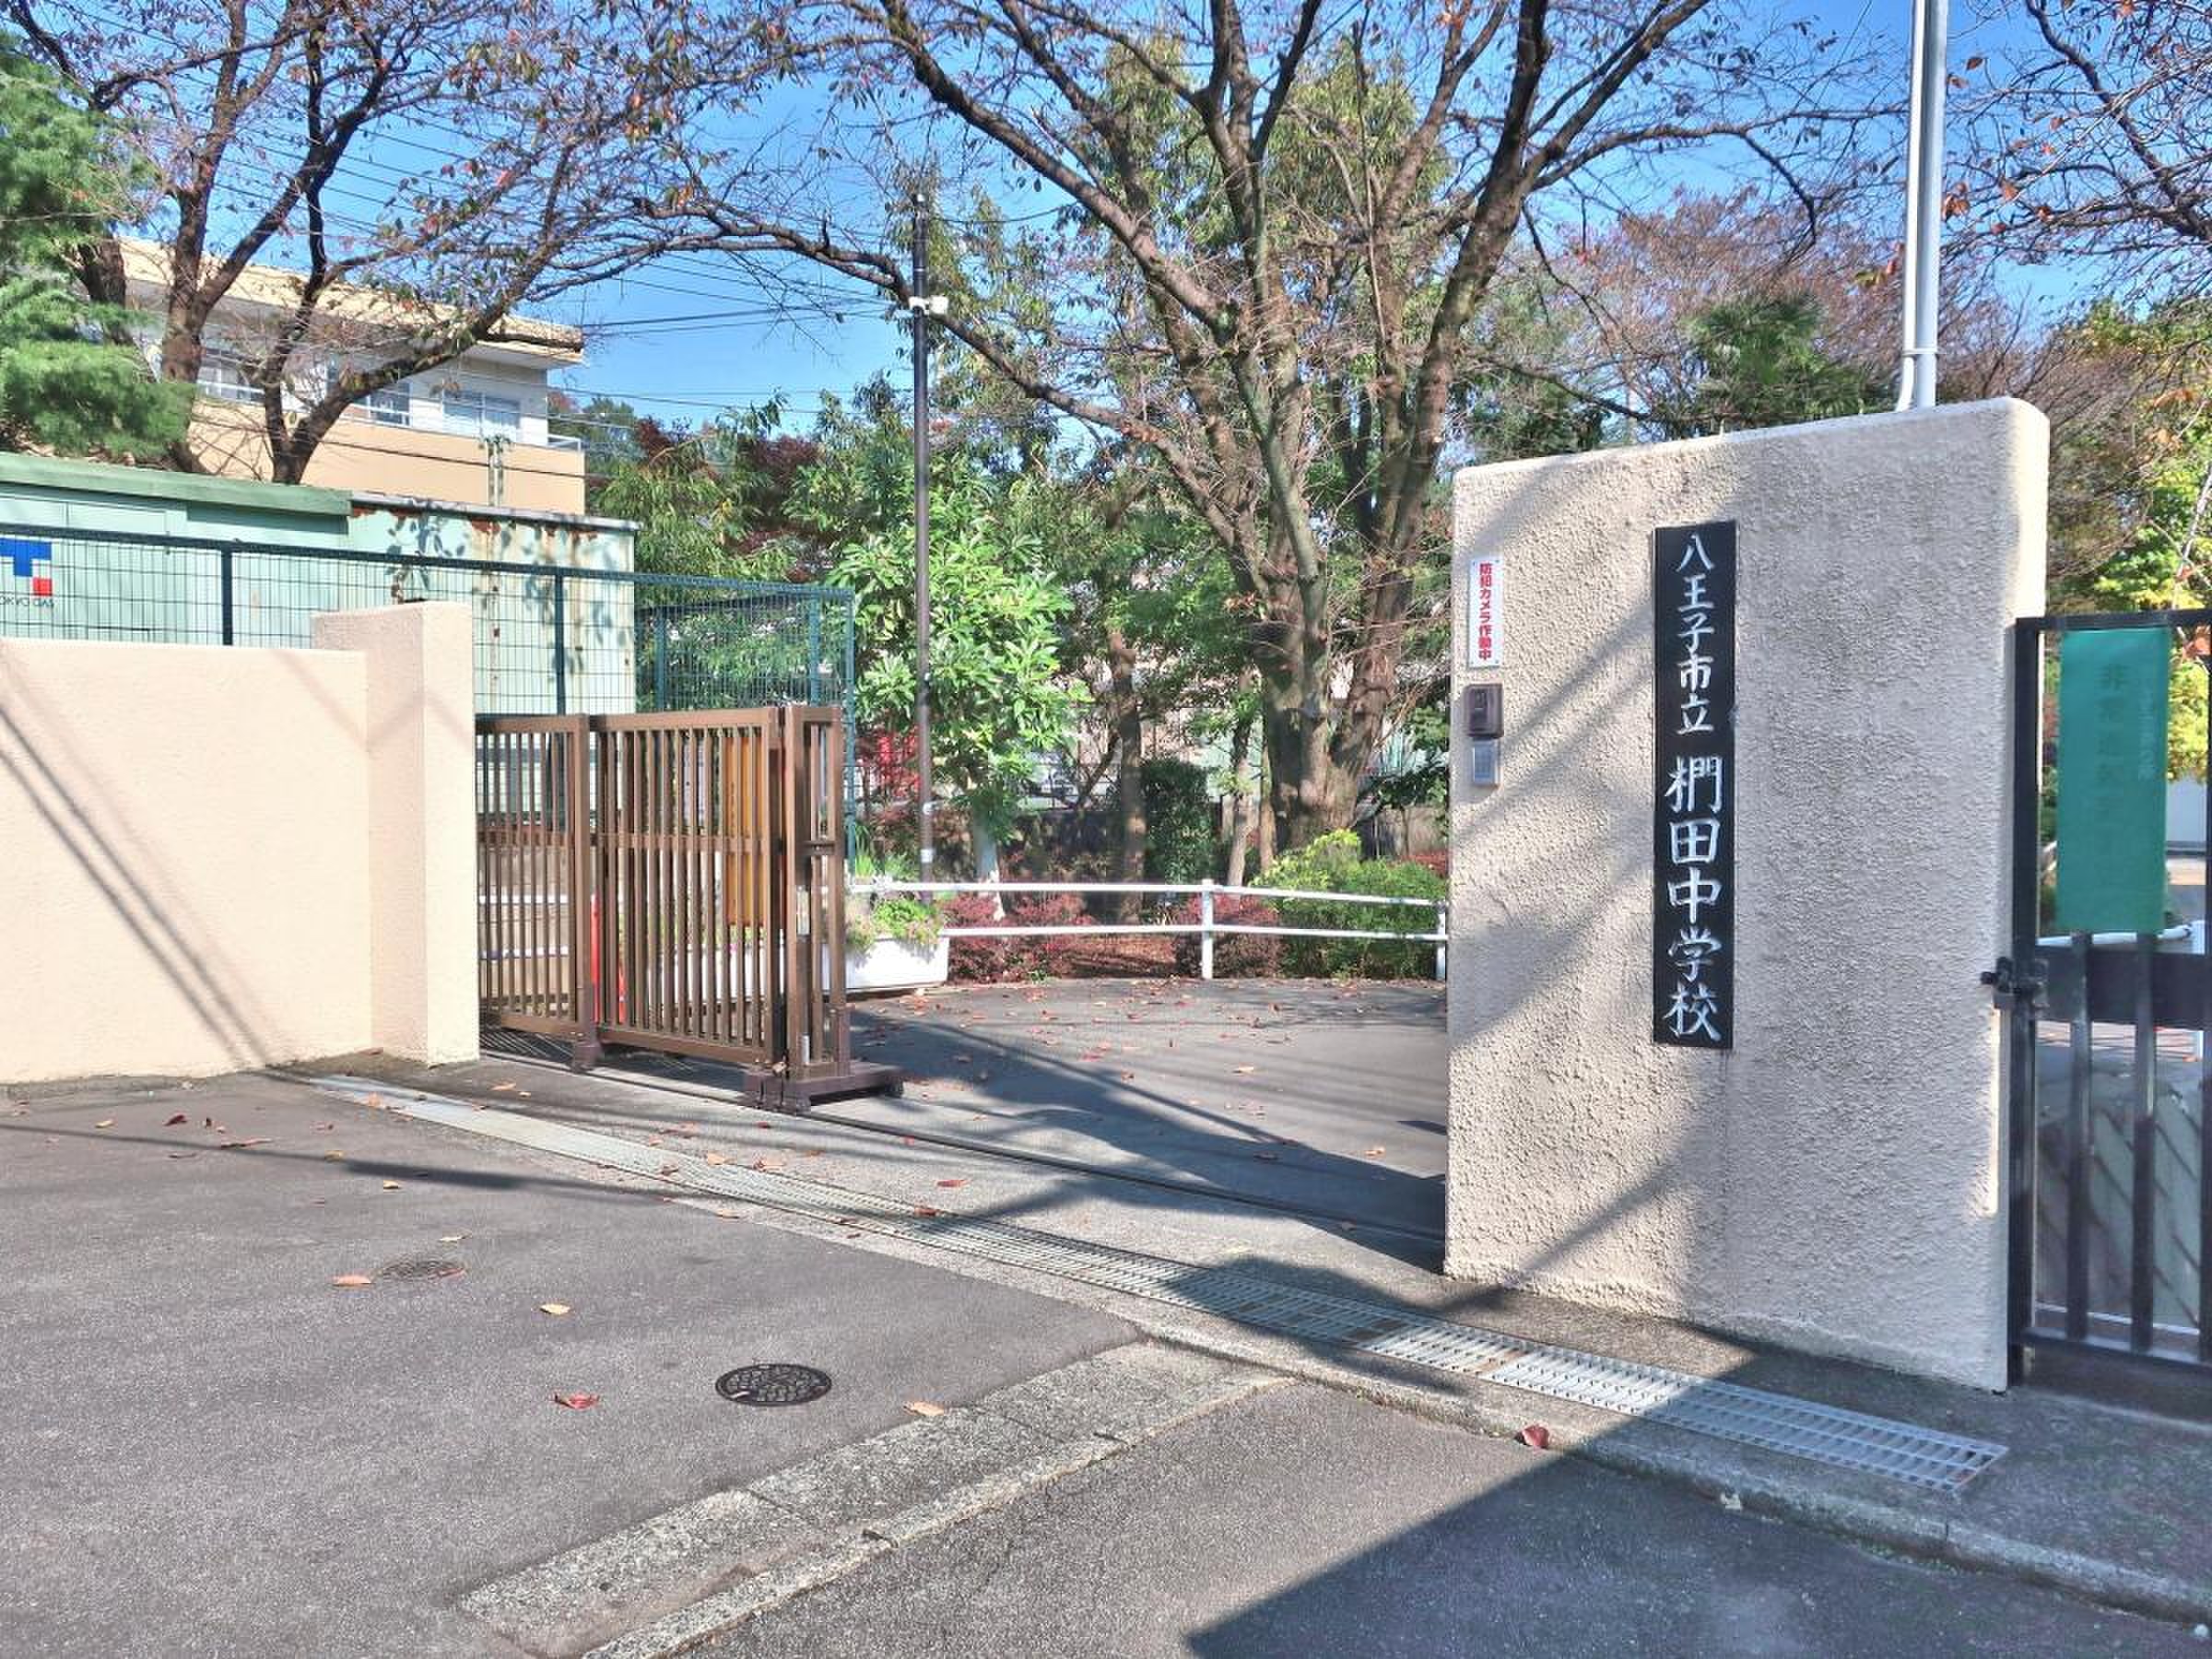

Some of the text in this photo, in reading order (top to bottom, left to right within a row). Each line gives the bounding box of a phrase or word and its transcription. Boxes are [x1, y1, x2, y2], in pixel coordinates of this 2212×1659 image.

[1478, 562, 1492, 661] 防犯カメラ作動中
[1662, 533, 1723, 1041] 八王子市立 椚田中学校
